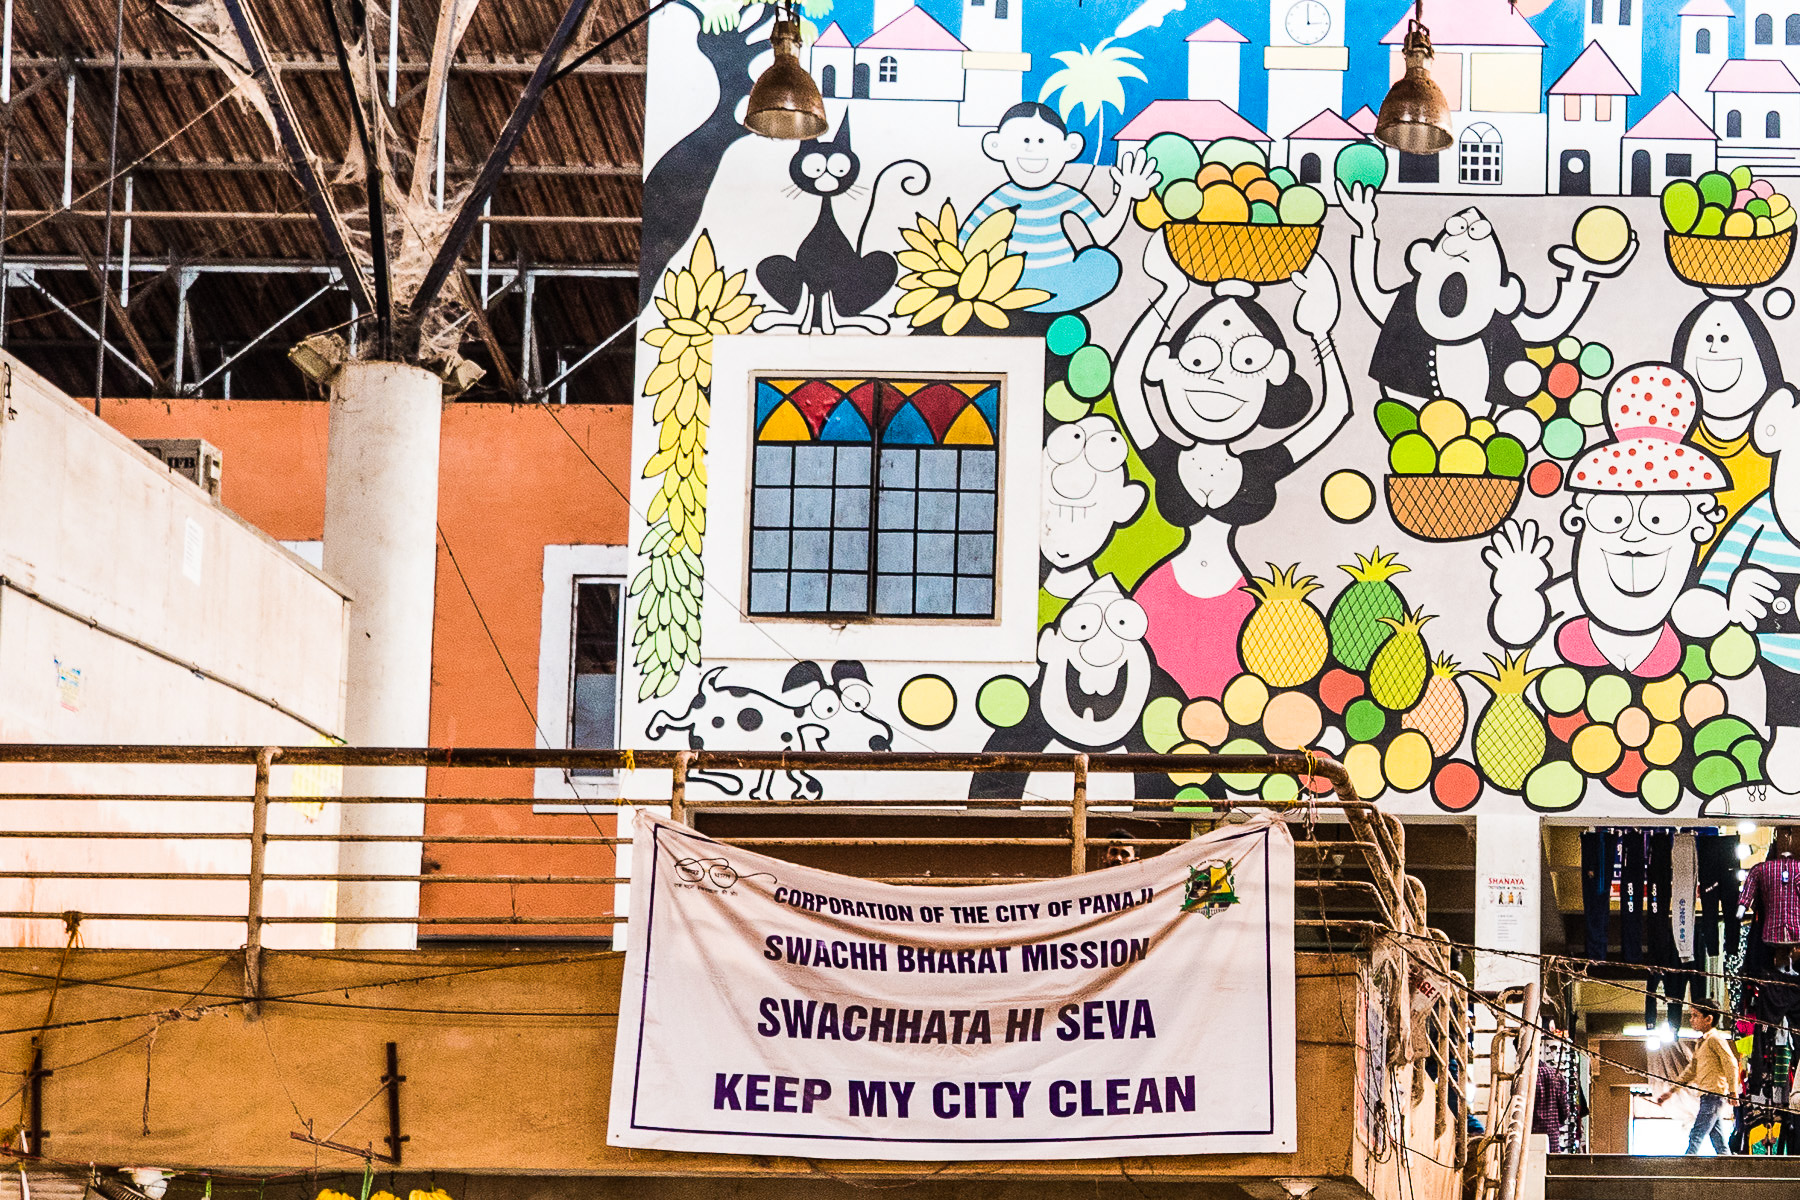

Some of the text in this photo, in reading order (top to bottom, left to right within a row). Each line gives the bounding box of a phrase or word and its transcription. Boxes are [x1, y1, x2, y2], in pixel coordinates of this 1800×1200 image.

[1488, 877, 1524, 885] SHANAYA
[773, 886, 1154, 924] CORPORATION OF THE CITY OF PANAJI
[763, 934, 1150, 974] SWACHH BHARAT MISSION
[758, 997, 1156, 1045] SWACHHATA HI SEVA
[714, 1072, 1196, 1119] KEEP MY CITY CLEAN
